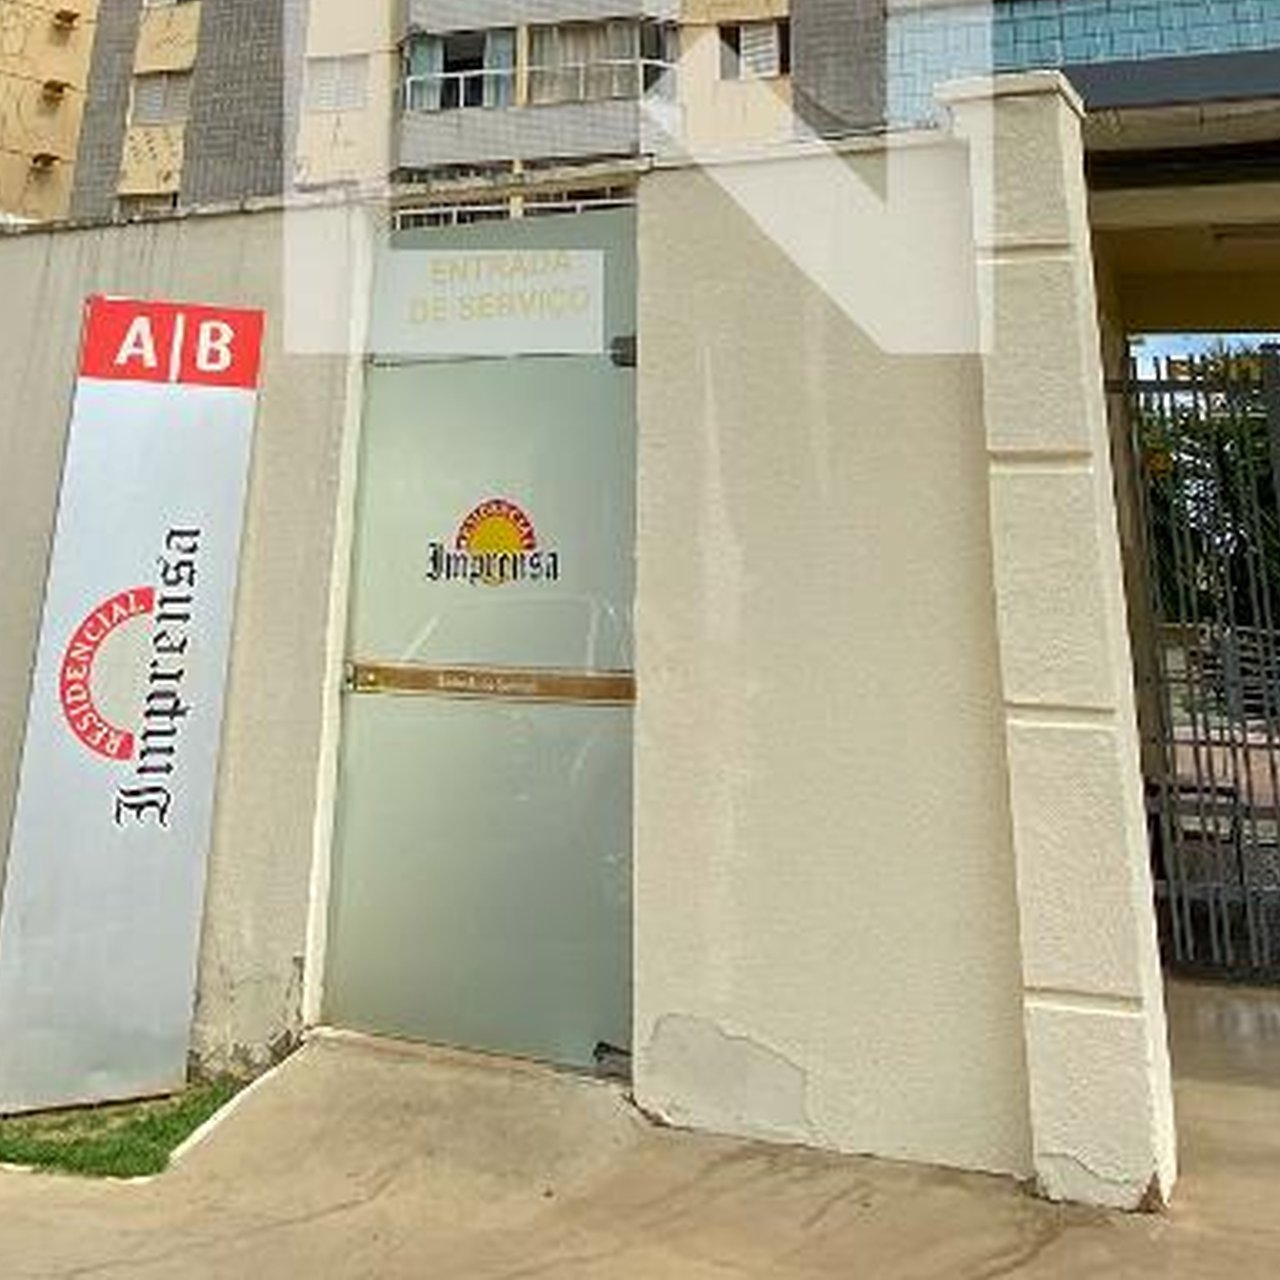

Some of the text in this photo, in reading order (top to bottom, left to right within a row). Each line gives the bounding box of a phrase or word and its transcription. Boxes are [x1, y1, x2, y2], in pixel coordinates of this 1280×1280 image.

[428, 249, 573, 284] ENTRADA
[409, 296, 448, 324] DE
[425, 542, 559, 587] Imprensa
[63, 590, 146, 757] RESIDENCIAL
[116, 527, 202, 827] Imprensa
